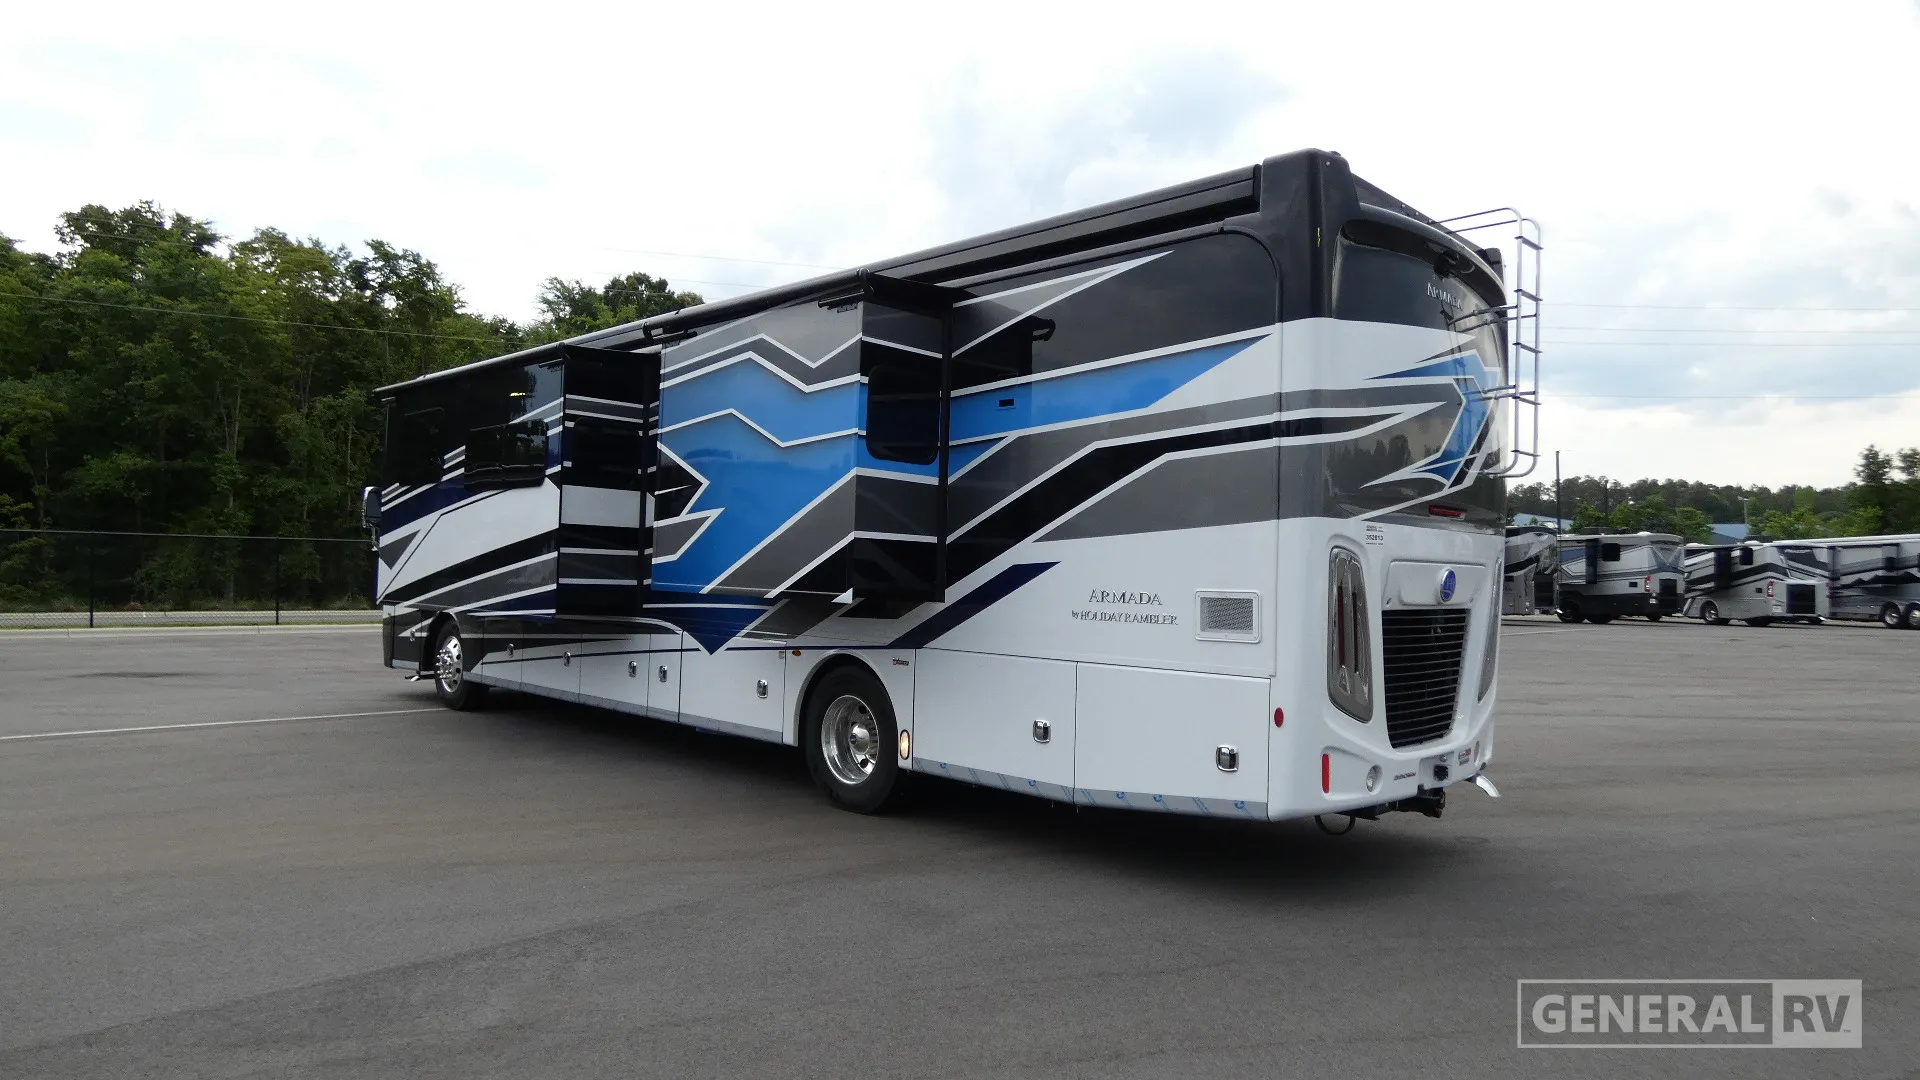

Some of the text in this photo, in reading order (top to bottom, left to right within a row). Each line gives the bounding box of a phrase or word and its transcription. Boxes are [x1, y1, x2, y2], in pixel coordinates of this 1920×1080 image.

[1427, 282, 1463, 312] ARMADA
[1088, 588, 1163, 606] ARMADA
[1071, 610, 1179, 625] by HOLIDAY RAMBLER
